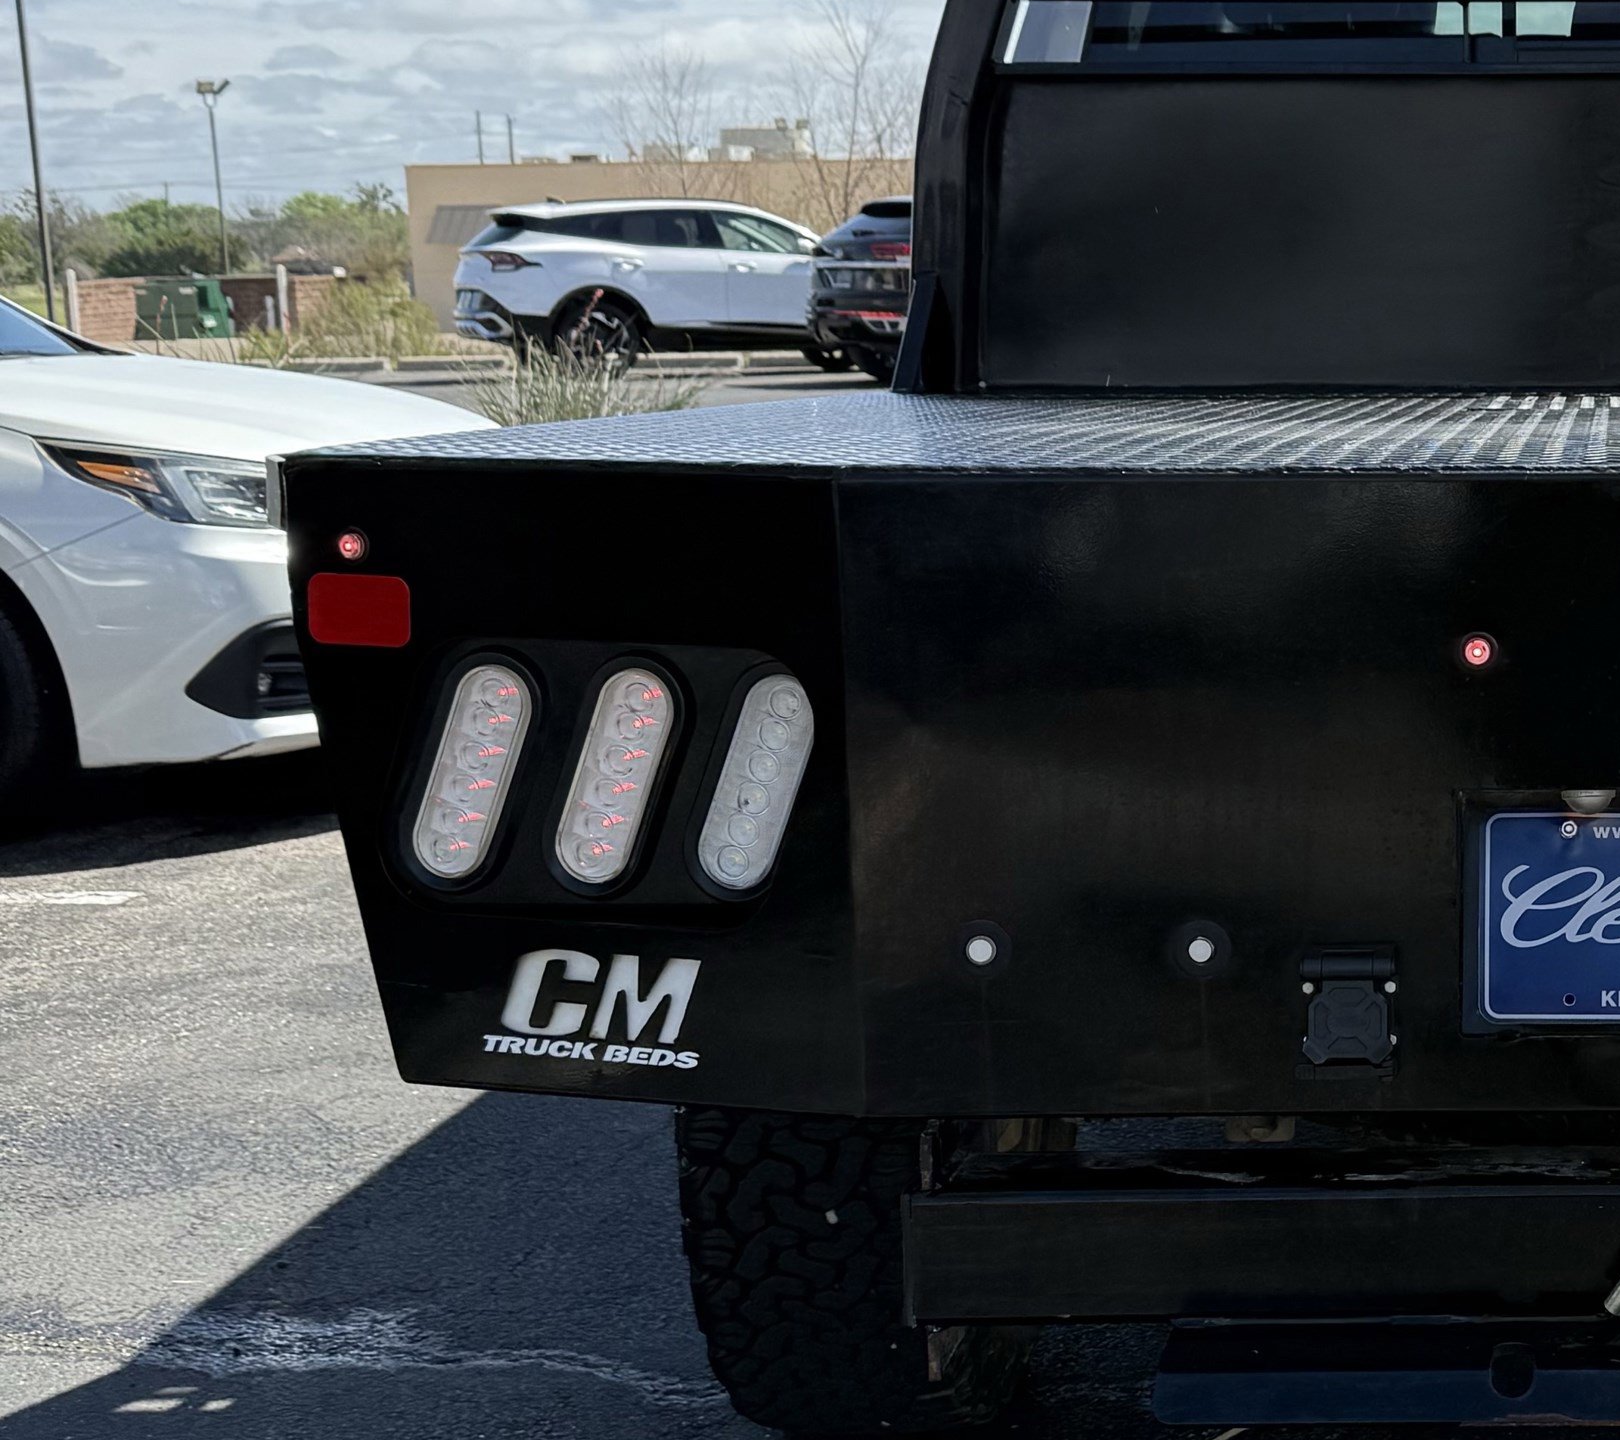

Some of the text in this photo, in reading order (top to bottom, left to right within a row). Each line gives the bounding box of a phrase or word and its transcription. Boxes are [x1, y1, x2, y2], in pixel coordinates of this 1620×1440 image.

[500, 948, 702, 1045] CM
[482, 1034, 700, 1070] TRUCK BEDS
